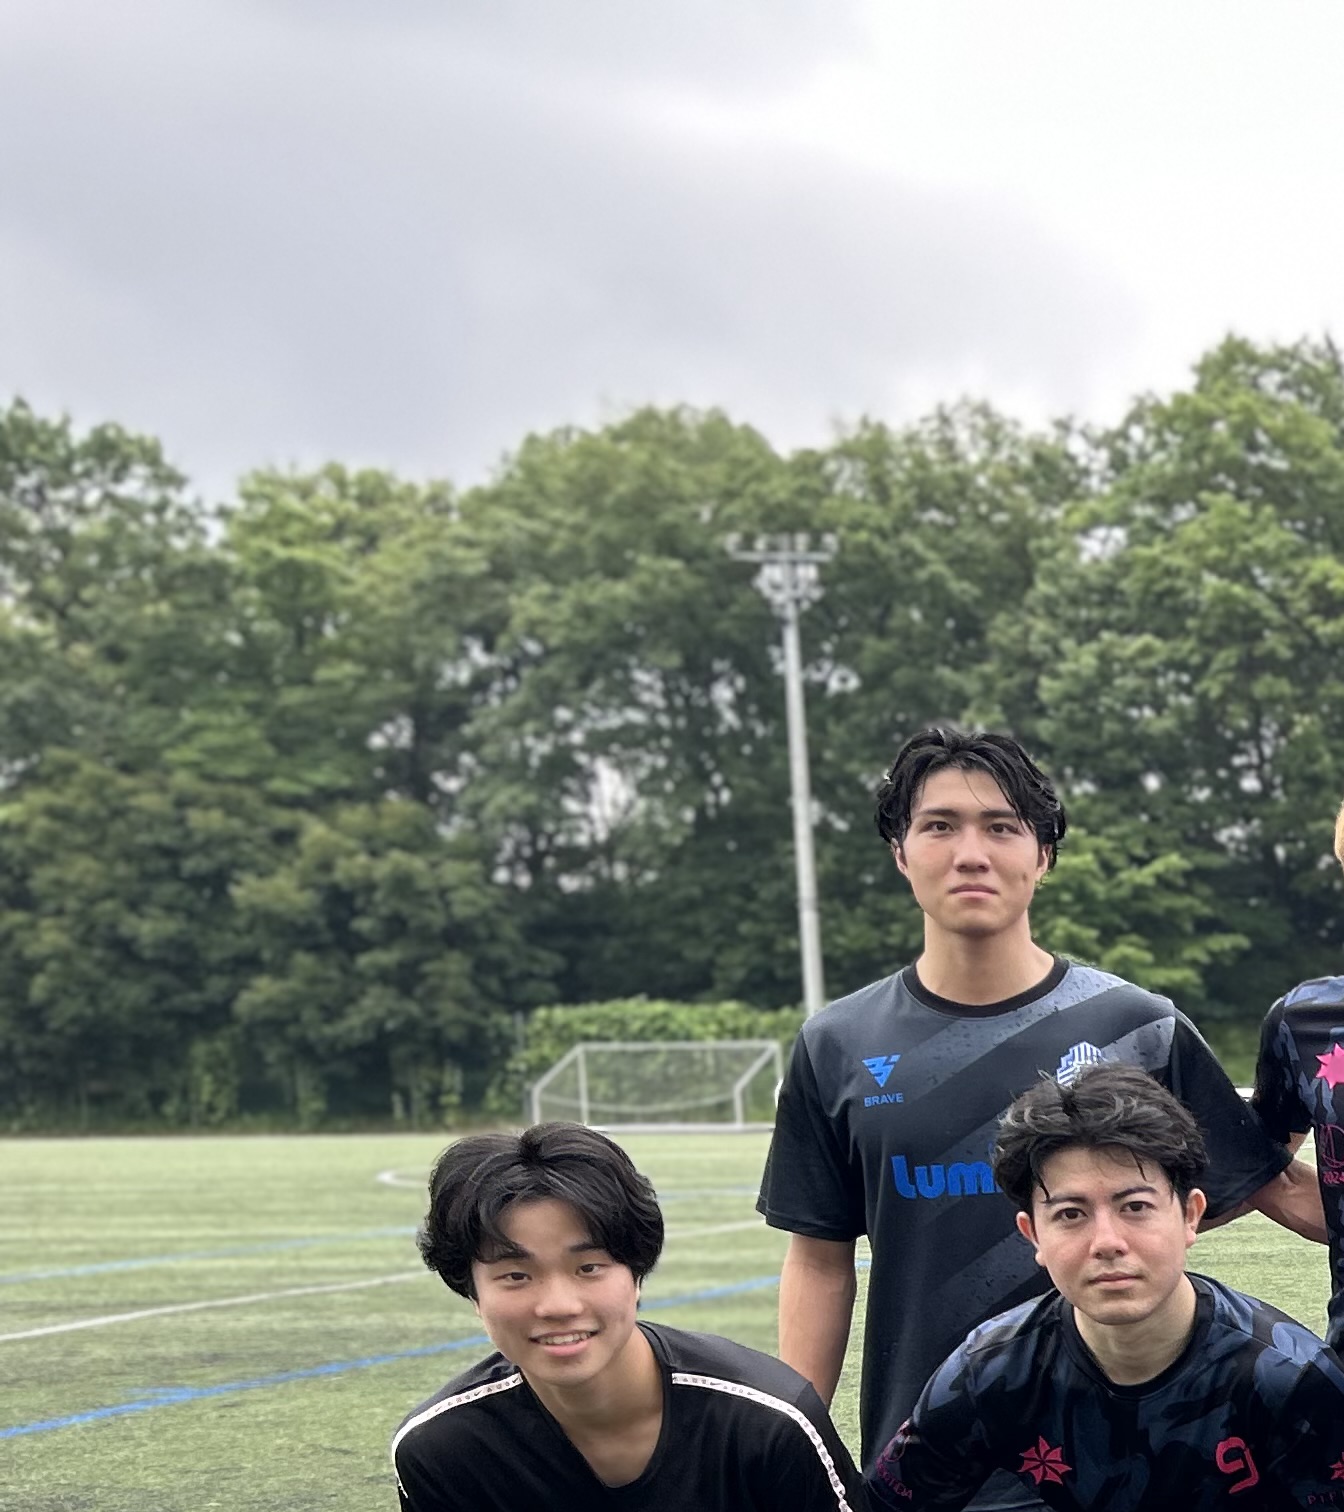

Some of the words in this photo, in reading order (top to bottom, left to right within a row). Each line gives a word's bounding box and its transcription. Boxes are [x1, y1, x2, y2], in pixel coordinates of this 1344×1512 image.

[863, 1092, 904, 1108] BRAVE
[891, 1154, 1003, 1199] lum
[1215, 1437, 1259, 1494] 9
